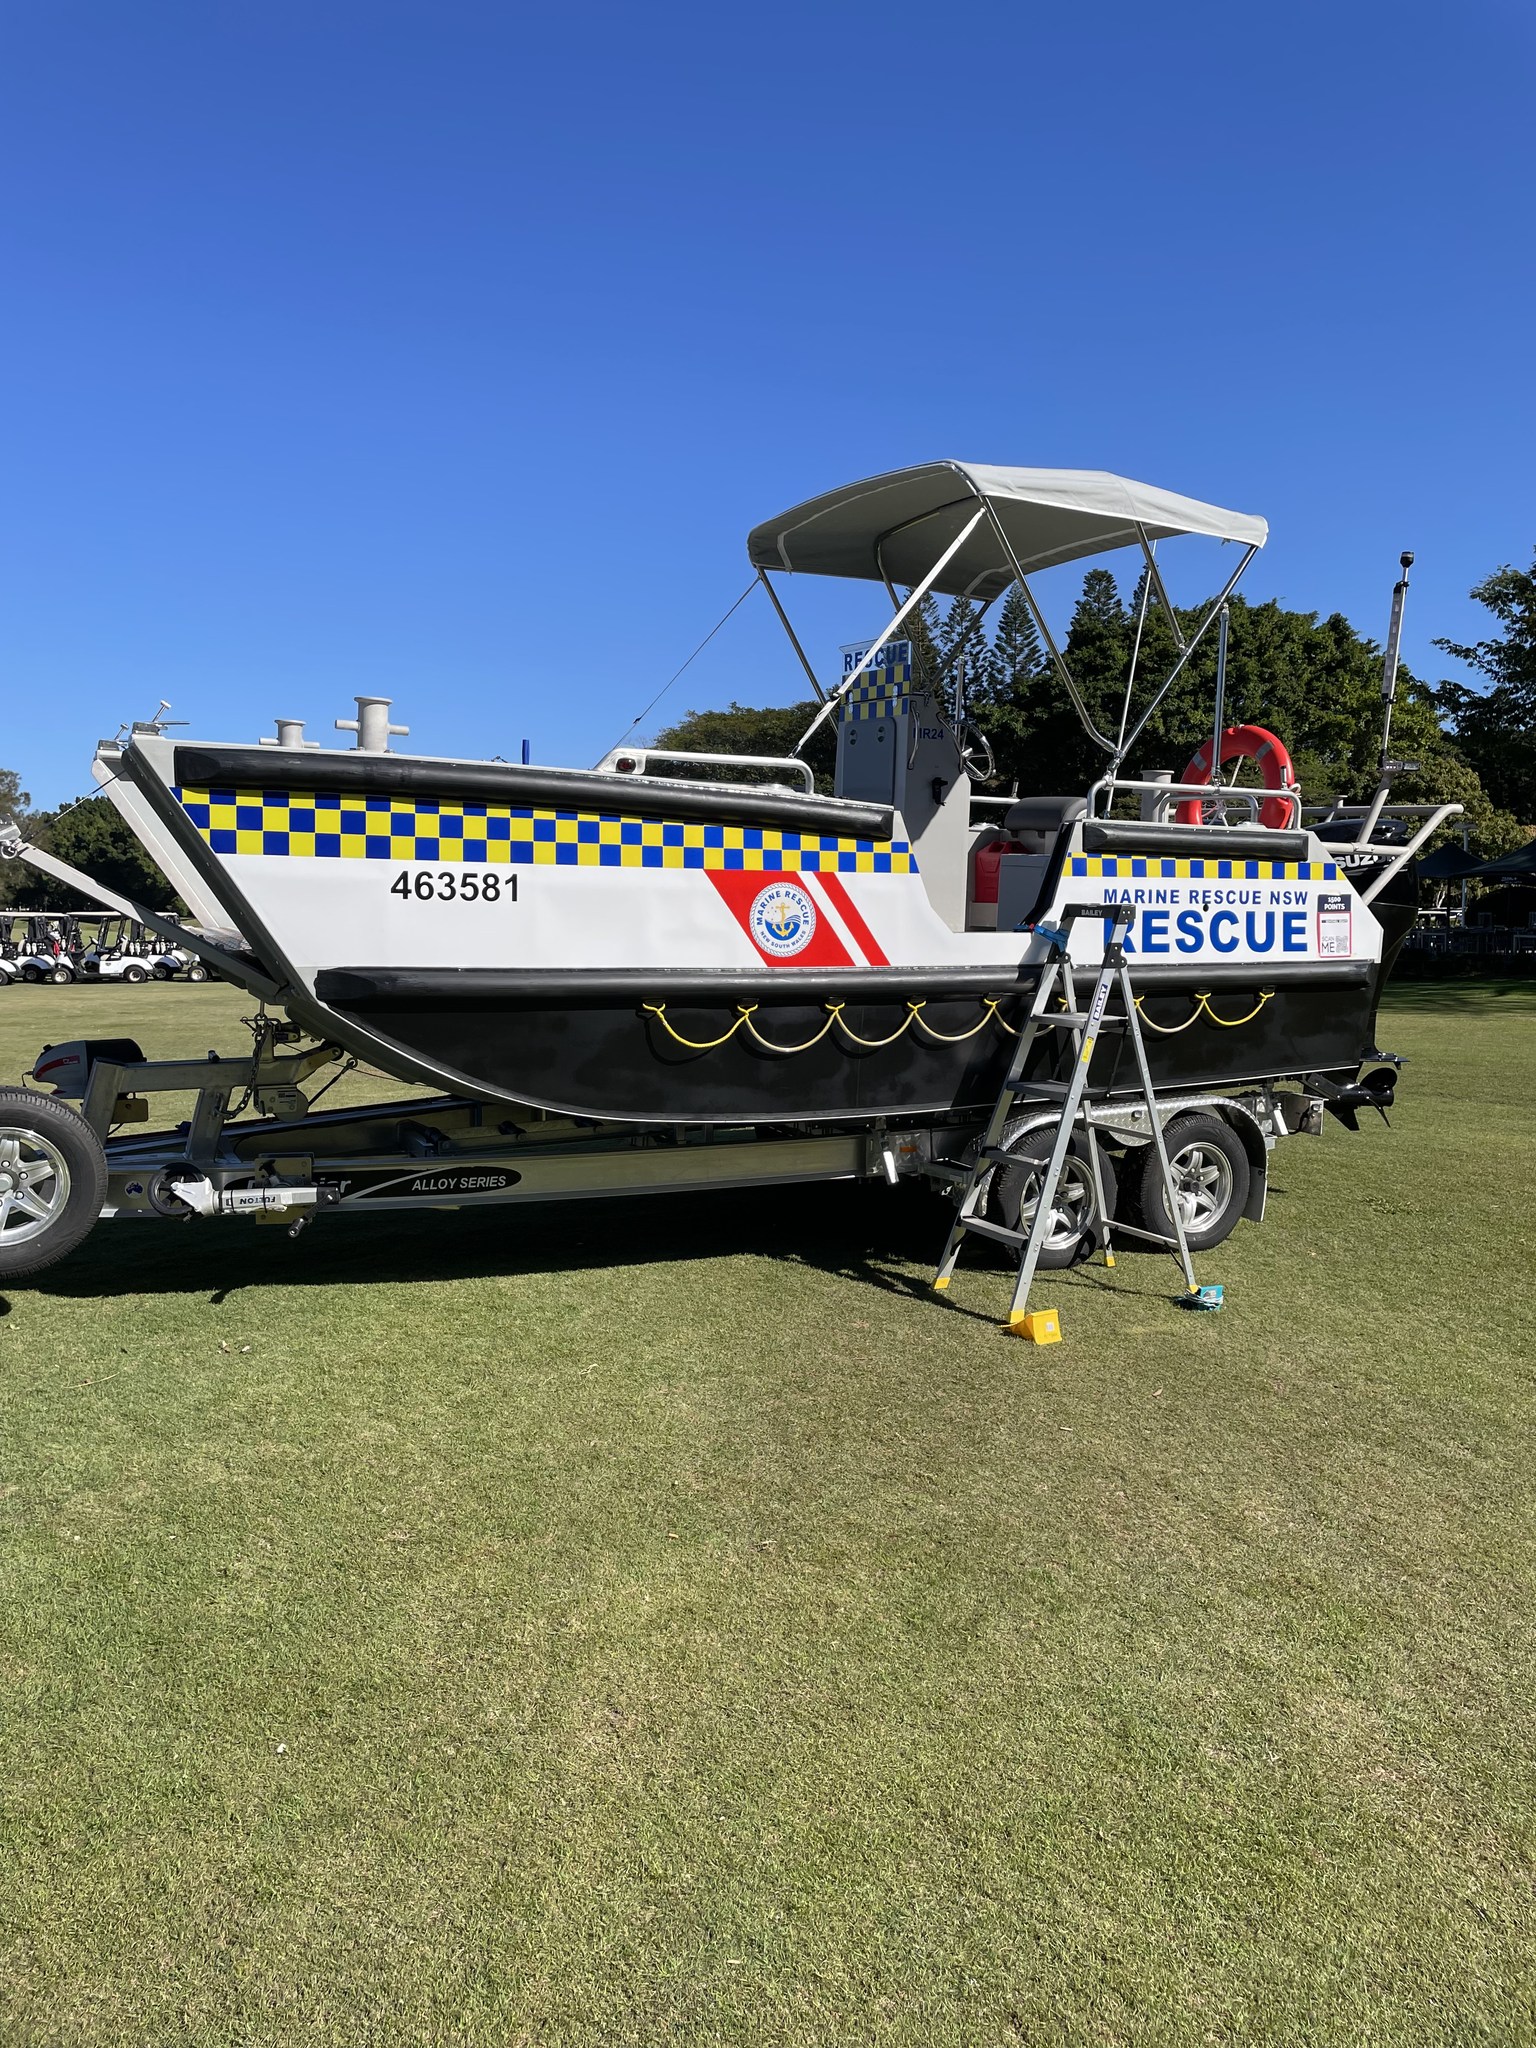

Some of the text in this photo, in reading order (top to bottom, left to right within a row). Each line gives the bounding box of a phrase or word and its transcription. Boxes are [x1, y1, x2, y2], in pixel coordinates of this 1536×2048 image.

[390, 870, 518, 902] 463581
[1103, 889, 1308, 905] MARINE RESCUE NSW
[756, 890, 810, 926] MARINE RESCUE
[760, 931, 806, 949] NEW SOUTH WALES
[1321, 942, 1335, 953] ME
[1093, 984, 1107, 1019] BAILEY
[411, 1176, 507, 1191] ALLOY SERIES
